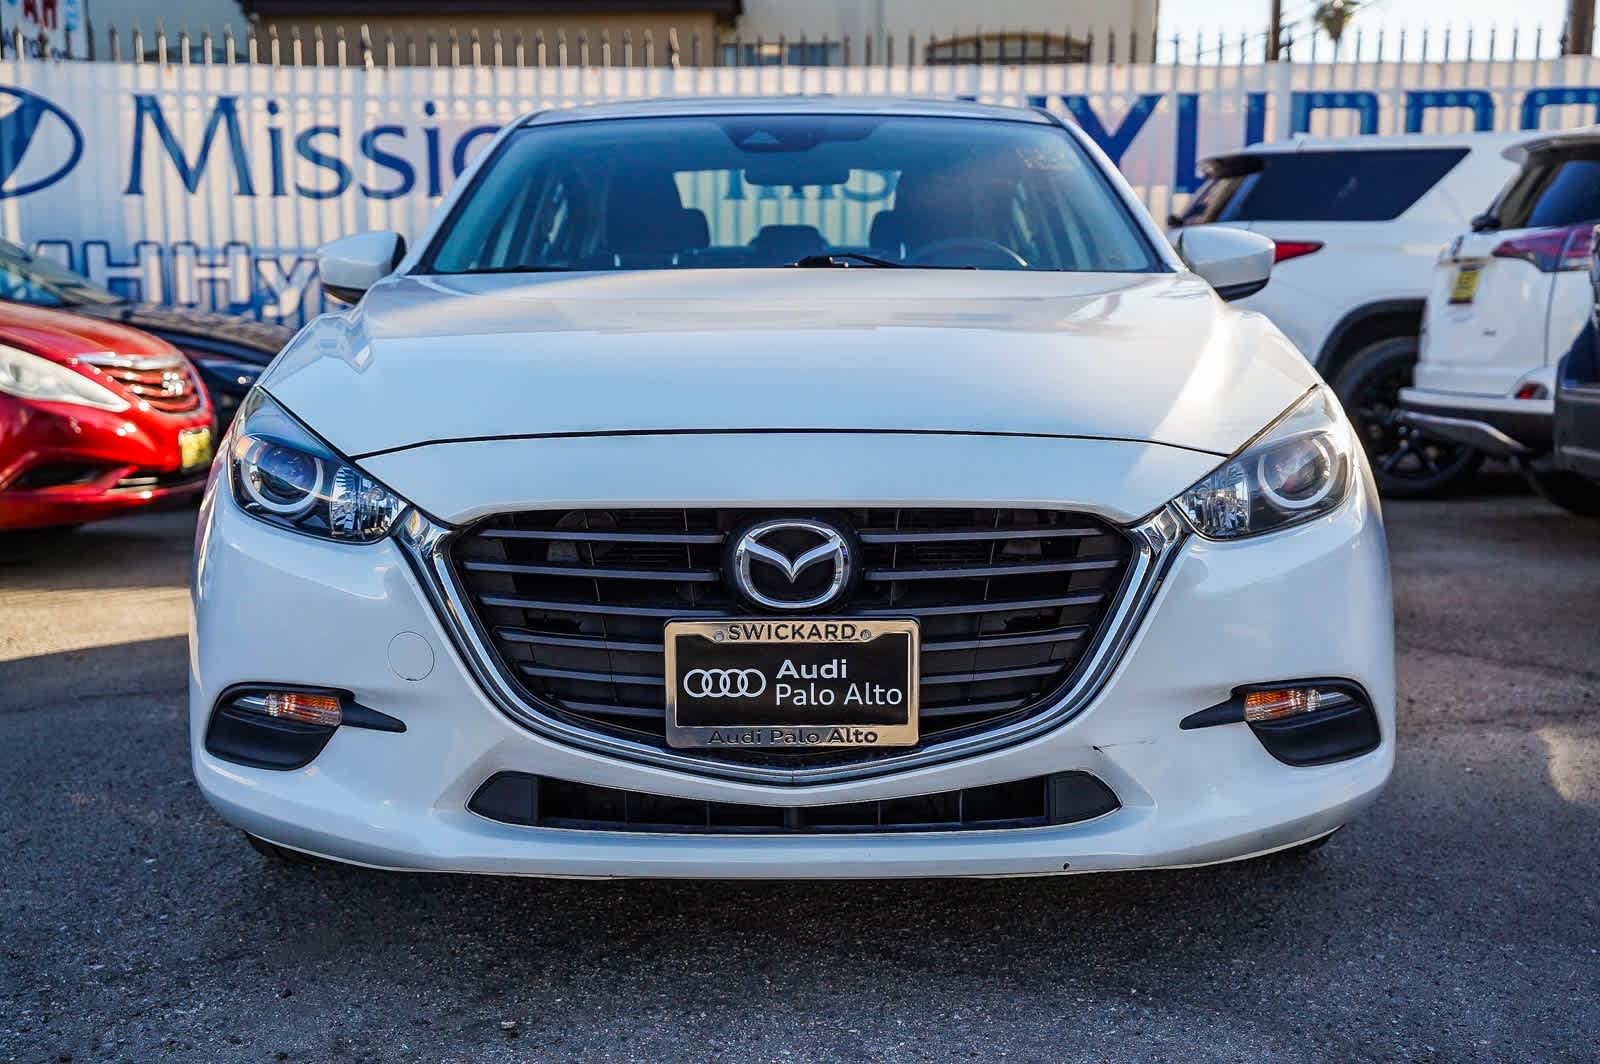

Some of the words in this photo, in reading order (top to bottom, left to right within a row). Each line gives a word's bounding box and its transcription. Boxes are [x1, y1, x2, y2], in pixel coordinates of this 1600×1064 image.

[728, 623, 857, 641] SWICKARD
[775, 658, 847, 679] Audi
[775, 682, 835, 707] Palo
[843, 681, 903, 706] Alto
[707, 730, 762, 745] Audi
[769, 730, 820, 745] Palo
[827, 728, 879, 744] Alto
